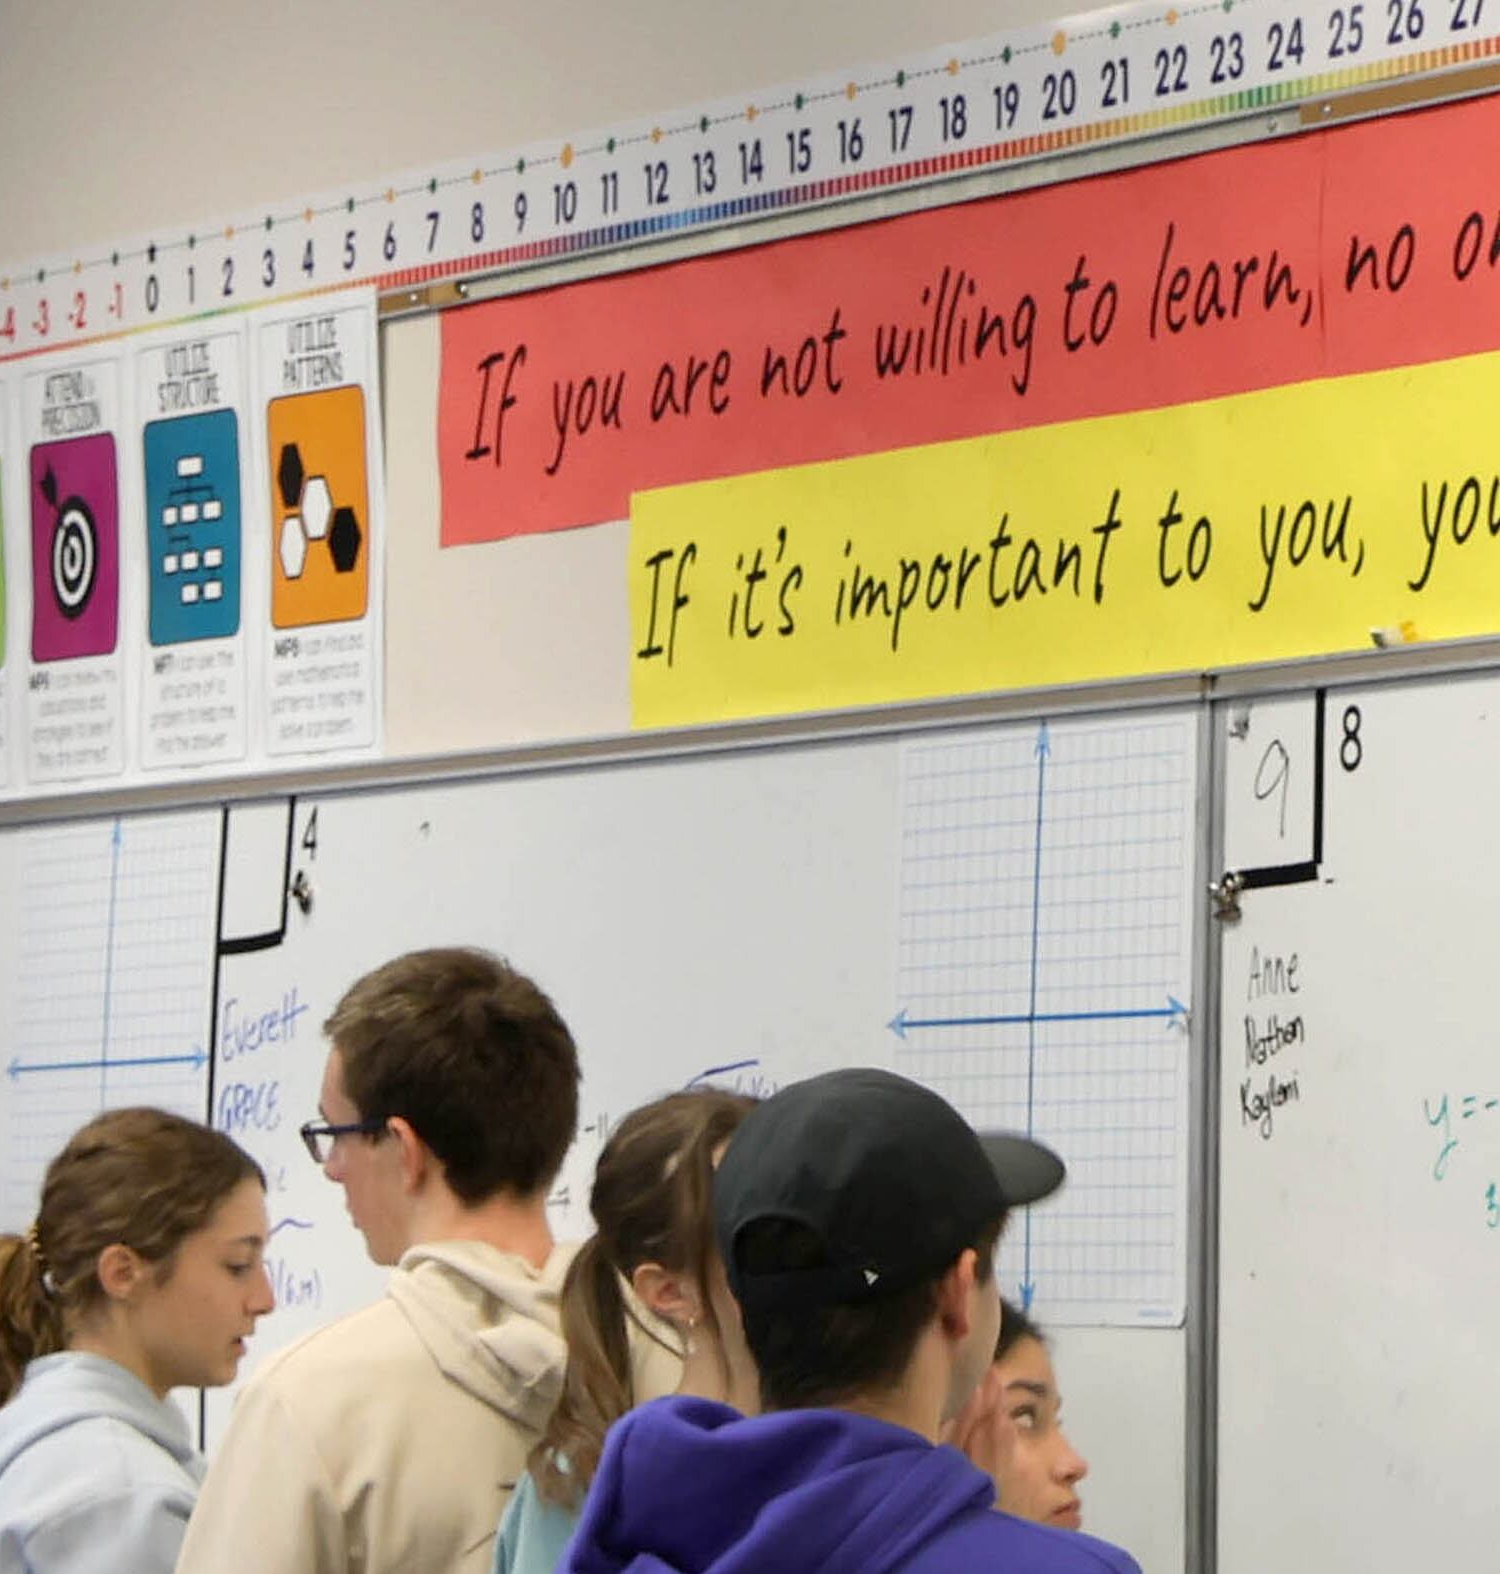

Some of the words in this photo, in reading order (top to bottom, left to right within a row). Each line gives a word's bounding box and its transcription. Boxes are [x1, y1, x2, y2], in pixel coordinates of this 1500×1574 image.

[33, 300, 48, 335] -3
[69, 291, 86, 328] -2
[109, 283, 122, 319] -1
[146, 274, 159, 312] 0
[188, 265, 195, 304] 1
[222, 257, 234, 296] 2
[263, 249, 275, 287] 3
[302, 239, 314, 278] 4
[343, 231, 356, 269] 5
[384, 222, 396, 260] 6
[427, 212, 440, 252] 7
[472, 203, 483, 242] 8
[515, 192, 527, 232] 9
[553, 182, 577, 225] 10
[601, 172, 618, 214] 11
[644, 161, 669, 204] 12
[693, 151, 716, 194] 13
[739, 140, 763, 184] 14
[787, 128, 812, 174] 15
[837, 118, 863, 163] 16
[889, 106, 913, 152] 17
[939, 95, 967, 141] 18
[993, 83, 1019, 130] 19
[1042, 70, 1076, 120] 20
[1101, 58, 1130, 106] 21
[1155, 46, 1188, 96] 22
[1210, 32, 1245, 83] 23
[1268, 18, 1304, 71] 24
[1329, 3, 1363, 57] 25
[1387, 0, 1424, 44] 26
[466, 346, 526, 466] If
[546, 363, 623, 474] you
[651, 347, 731, 423] are
[761, 308, 847, 396] not
[875, 267, 1035, 395] willing
[1062, 255, 1116, 353] to
[1150, 222, 1313, 340] learn,
[1346, 225, 1414, 293] no
[636, 541, 697, 667] If
[728, 526, 803, 640] it's
[833, 488, 1121, 650] important
[1157, 488, 1213, 588] to
[1249, 493, 1367, 612] you,
[1340, 705, 1362, 771] 8
[303, 806, 318, 860] 4
[1248, 946, 1299, 999] Anne
